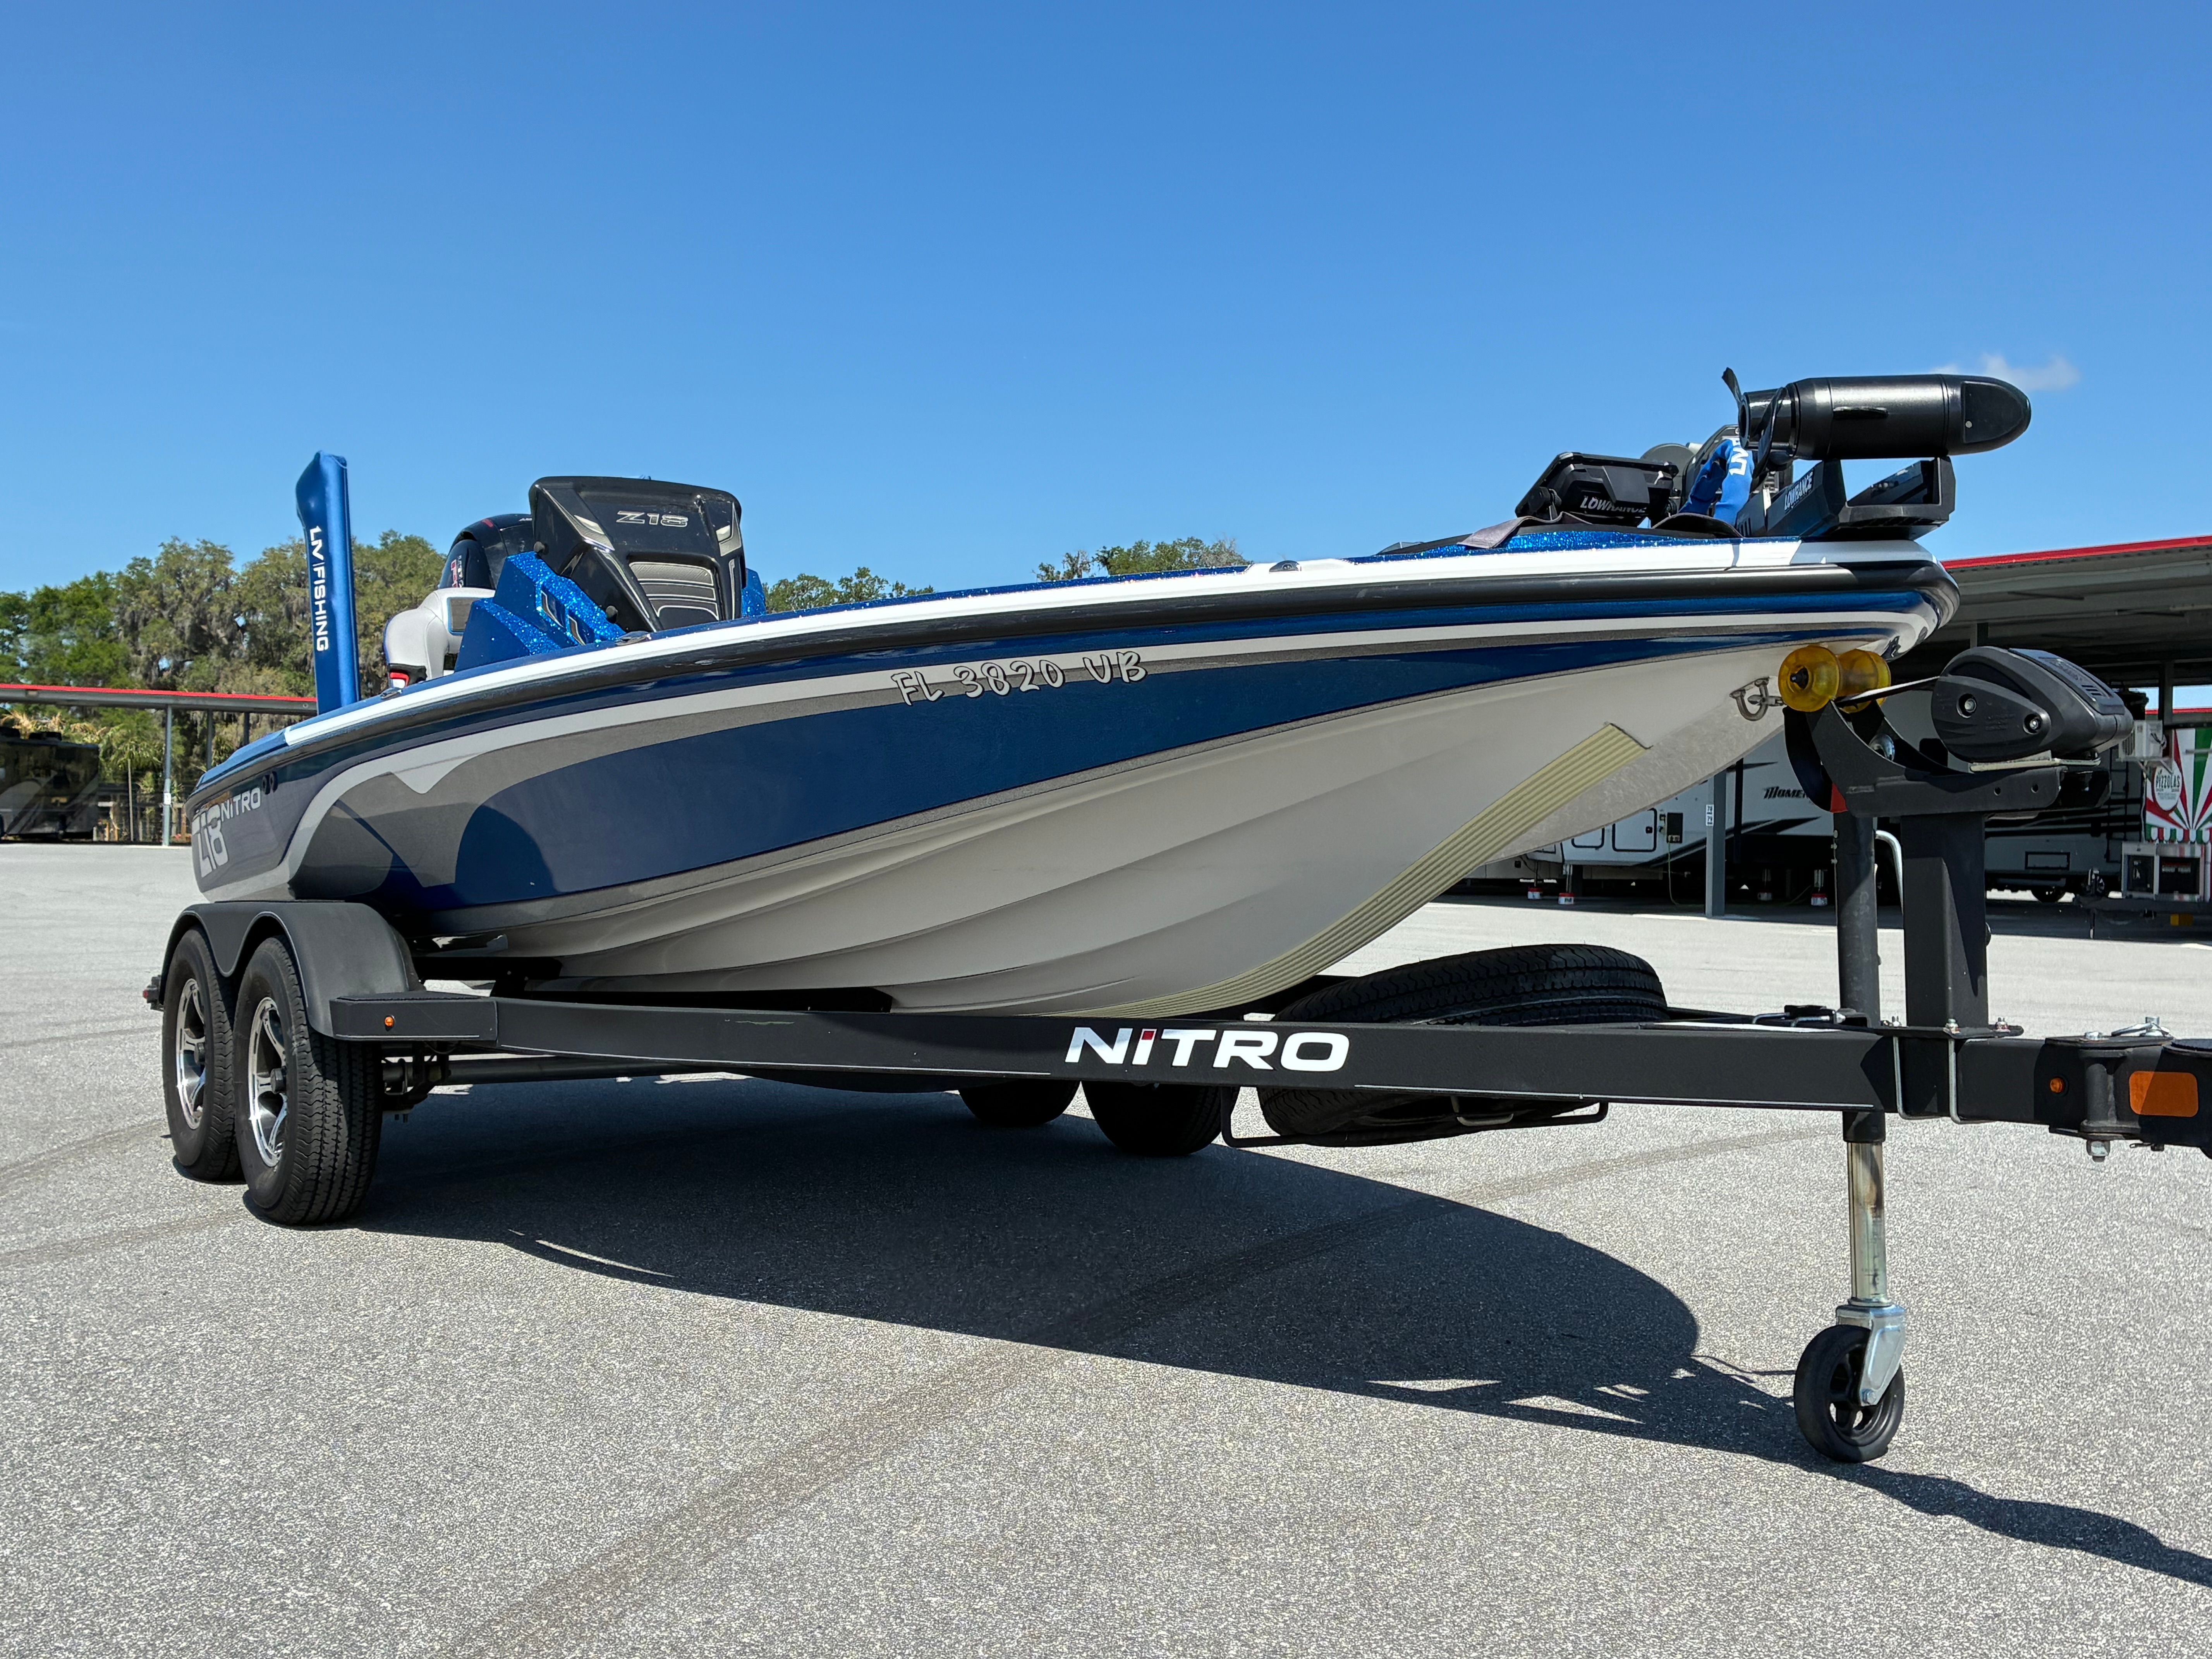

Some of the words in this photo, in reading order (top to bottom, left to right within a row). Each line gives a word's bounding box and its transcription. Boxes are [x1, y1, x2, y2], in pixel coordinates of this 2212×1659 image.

[1784, 471, 1813, 510] LOWRANCE
[616, 510, 689, 527] Z18
[313, 565, 329, 651] FISHING
[890, 671, 945, 706] FL
[953, 659, 1065, 699] 3820
